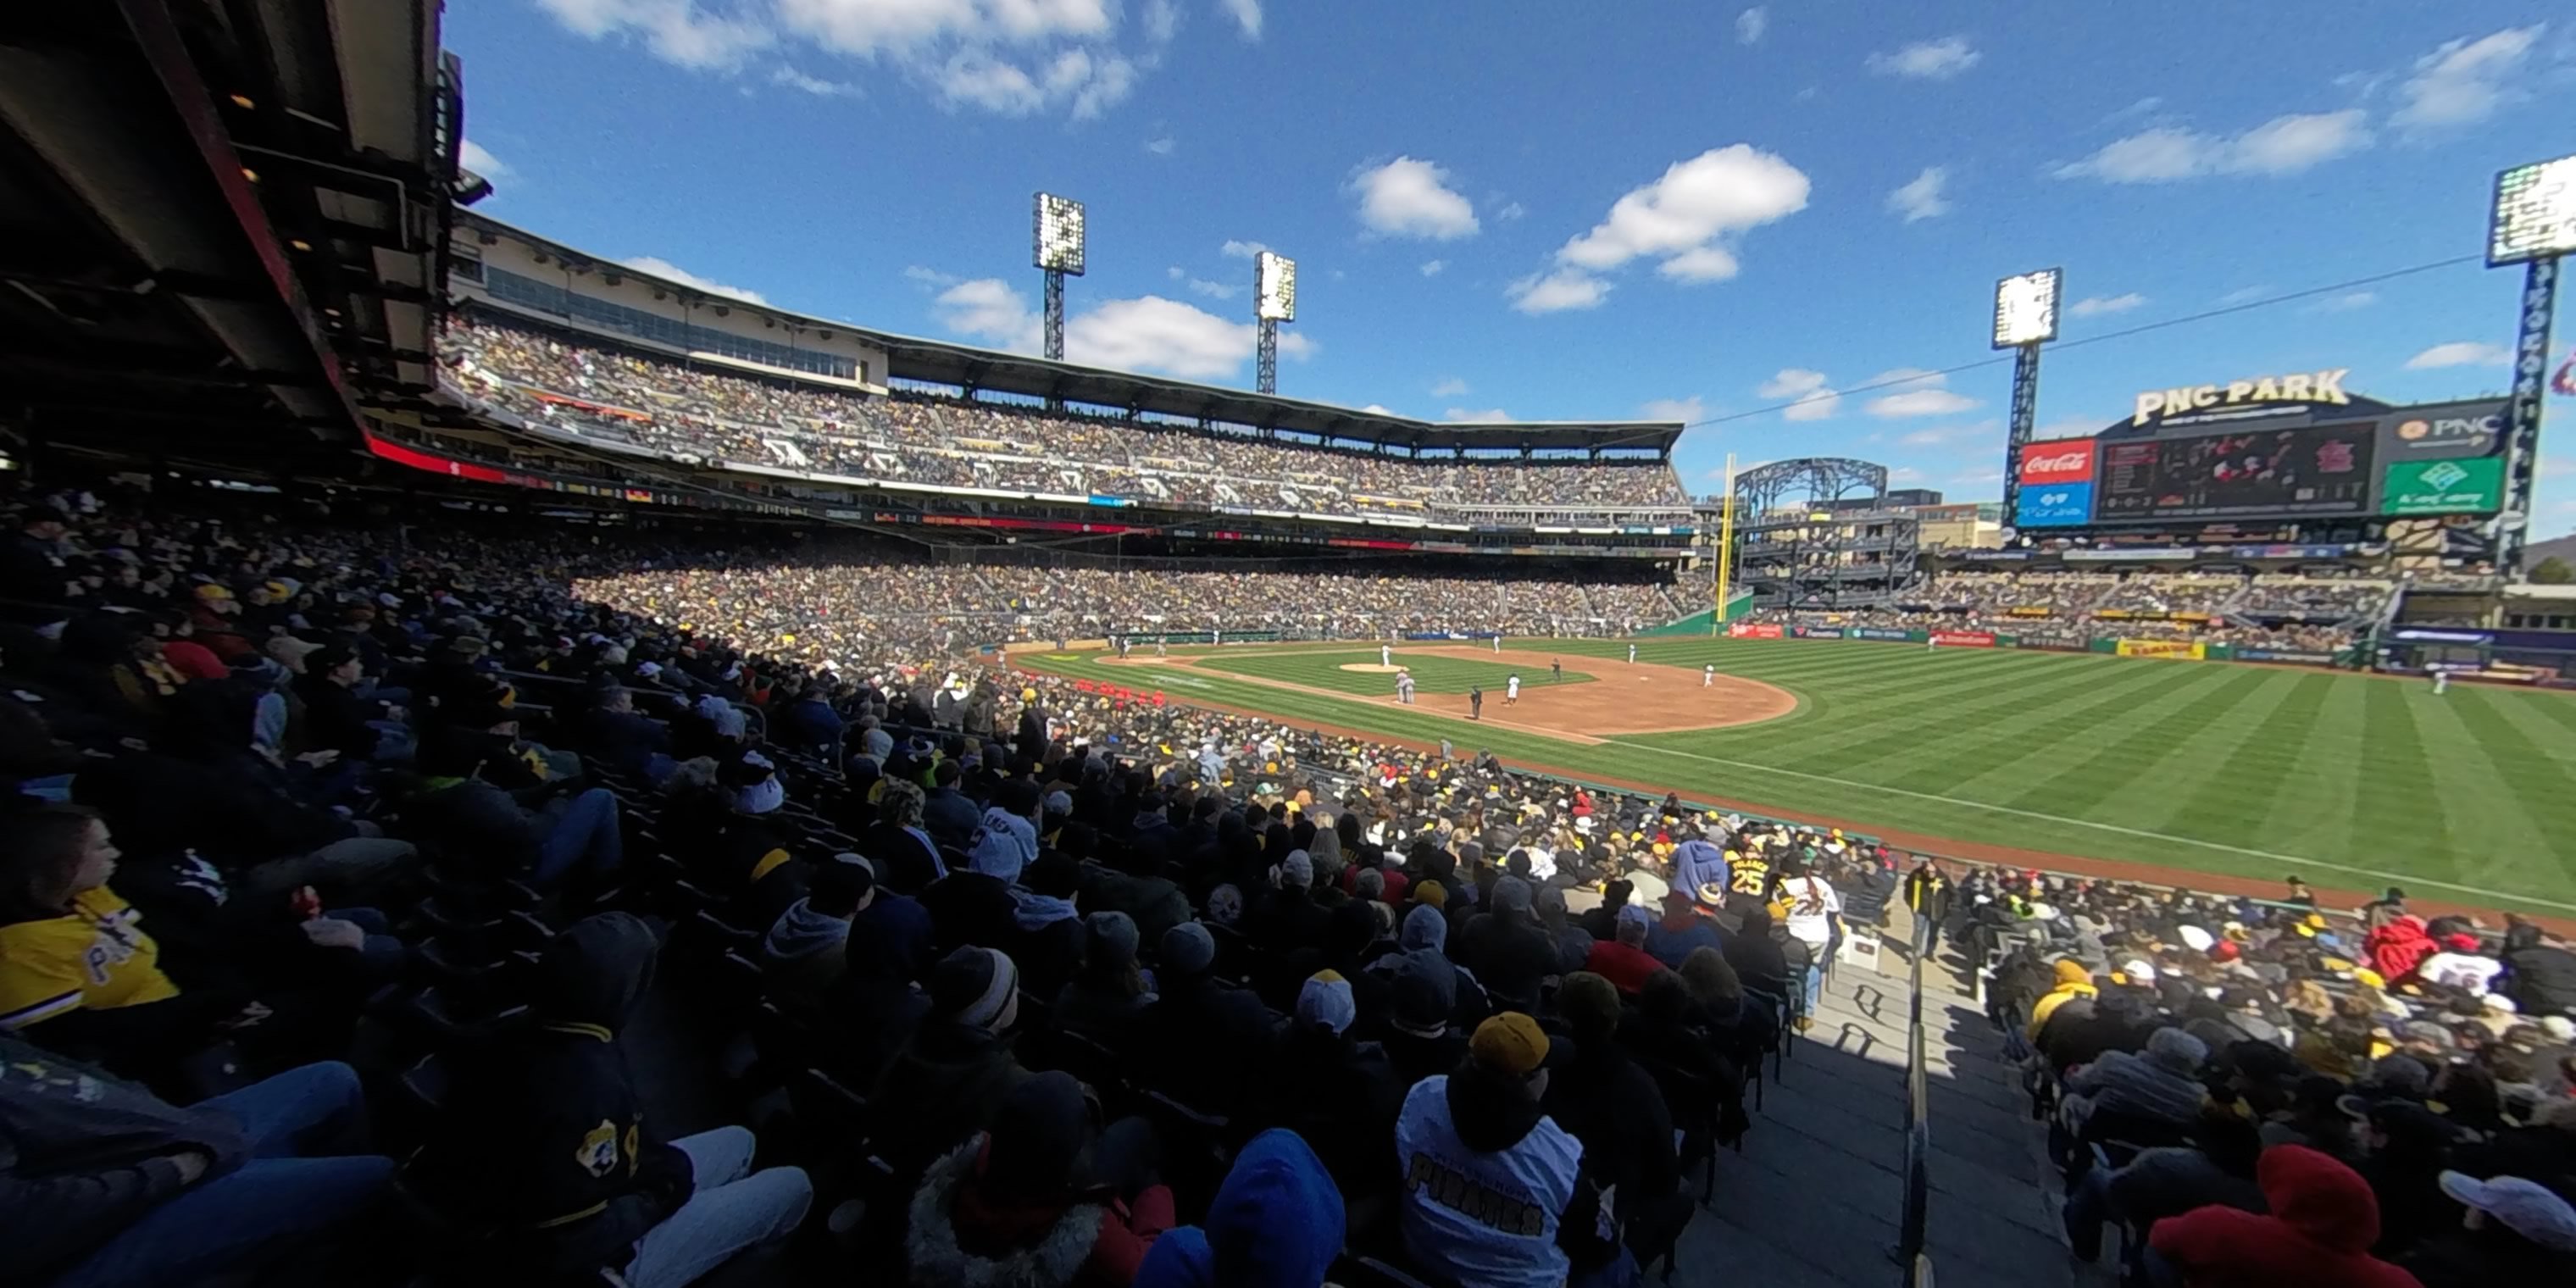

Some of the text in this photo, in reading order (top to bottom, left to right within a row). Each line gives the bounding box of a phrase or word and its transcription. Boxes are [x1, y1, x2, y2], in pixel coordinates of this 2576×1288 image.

[2133, 384, 2219, 427] PNC
[2226, 369, 2351, 405] PARK
[2433, 414, 2502, 436] PNC
[1731, 869, 1764, 896] 25
[1407, 1152, 1543, 1237] PIRATES
